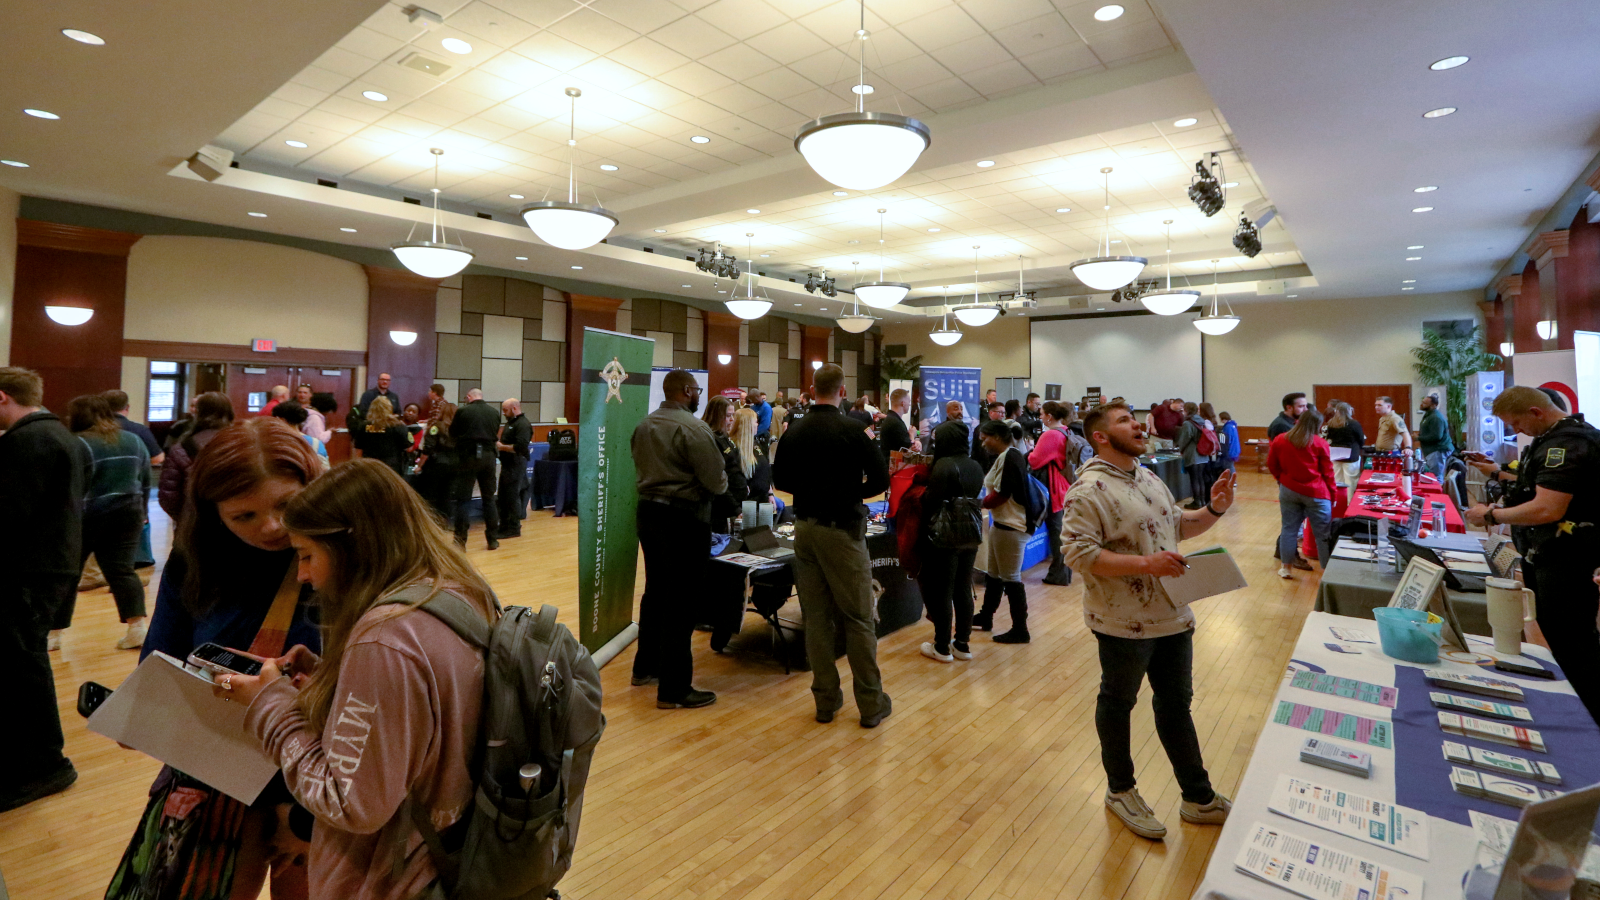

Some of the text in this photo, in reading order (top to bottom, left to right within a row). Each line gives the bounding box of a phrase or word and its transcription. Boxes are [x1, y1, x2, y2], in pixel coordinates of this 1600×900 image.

[257, 340, 273, 351] EXIT
[924, 379, 978, 400] SUIT
[594, 538, 602, 586] COUNTY
[598, 426, 606, 467] OFFICE
